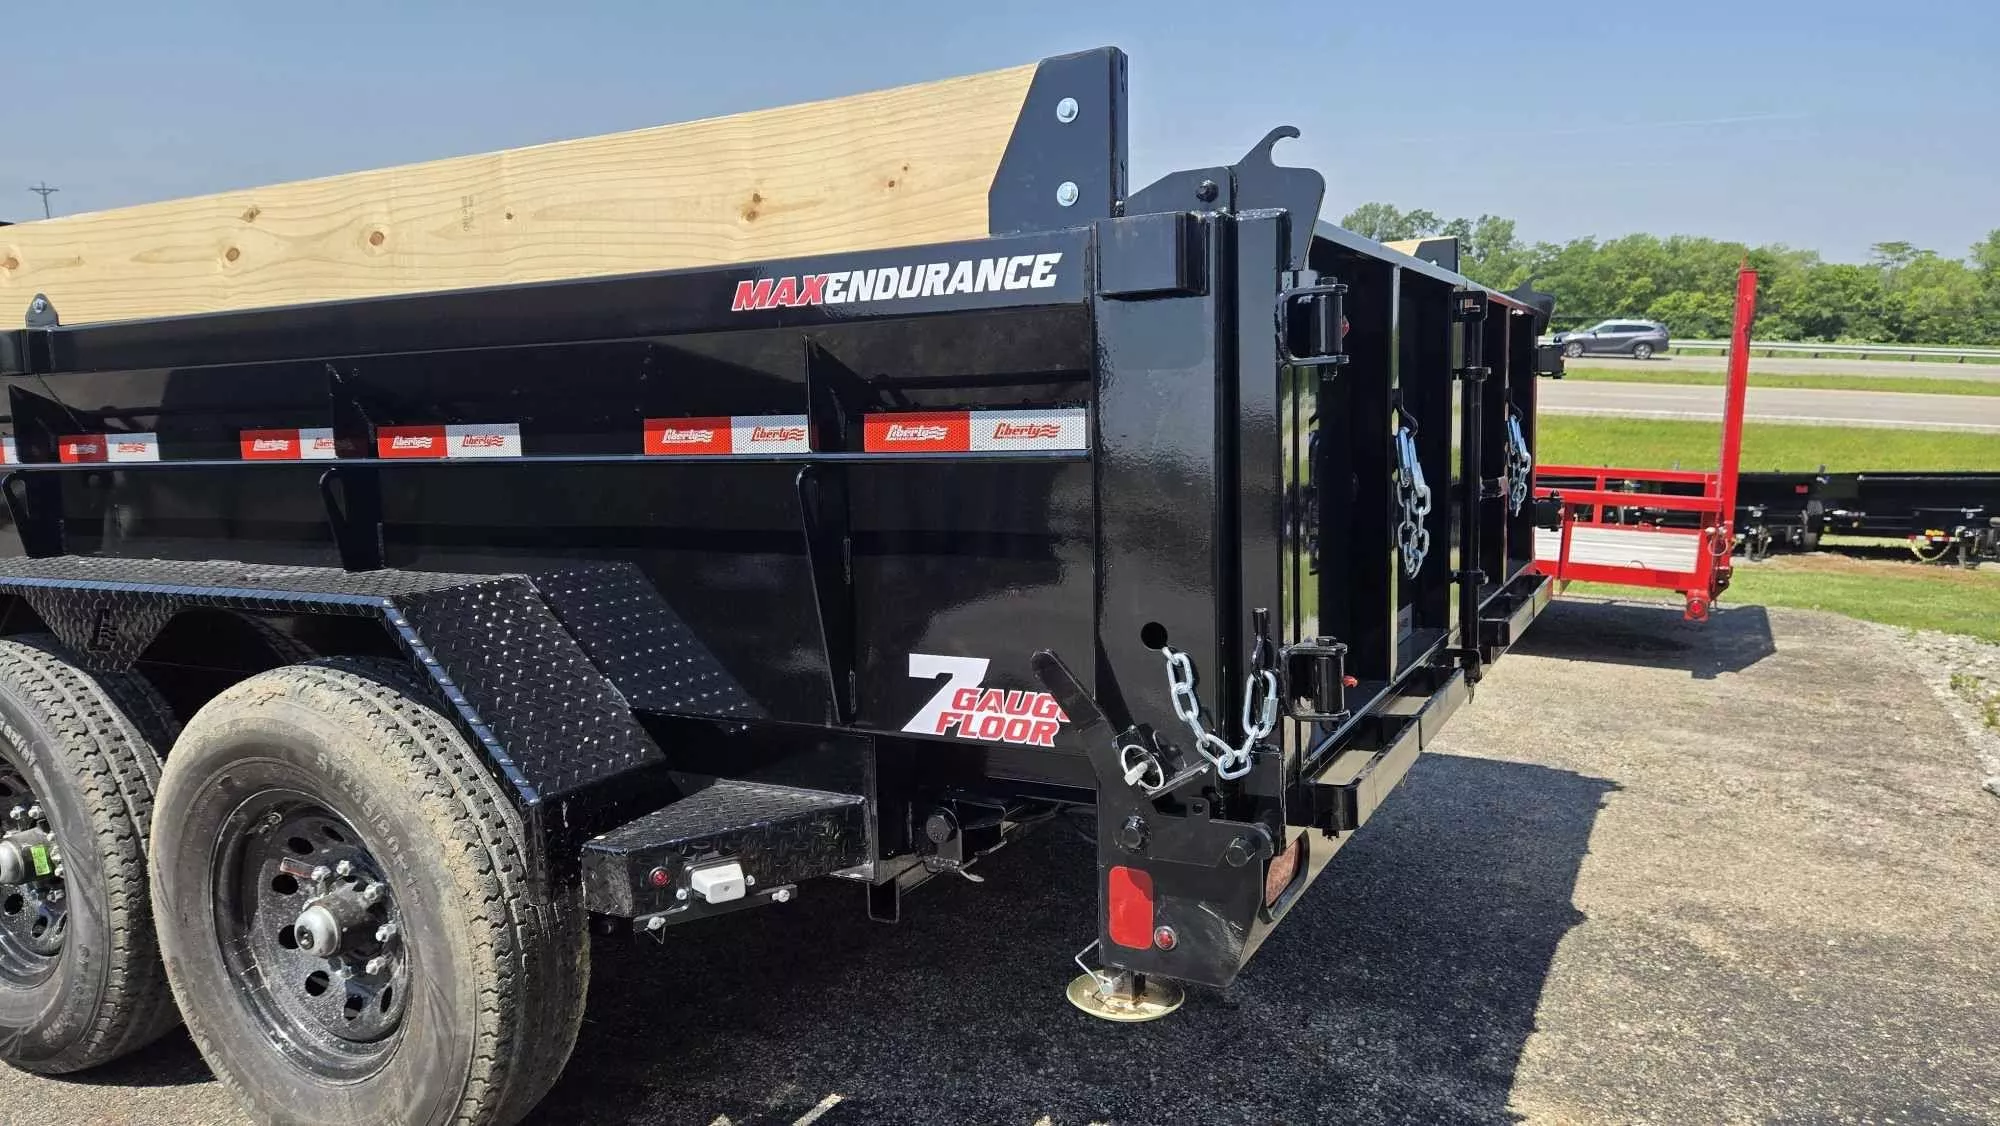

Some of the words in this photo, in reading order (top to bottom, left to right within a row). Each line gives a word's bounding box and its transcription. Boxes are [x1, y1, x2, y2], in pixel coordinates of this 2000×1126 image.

[662, 428, 704, 444] Liberty
[752, 427, 793, 442] Liberty
[885, 424, 939, 441] Liberty
[992, 422, 1043, 440] Liberty
[901, 653, 990, 735] 7
[951, 687, 1071, 722] GAUG
[935, 711, 1060, 748] FLOOR
